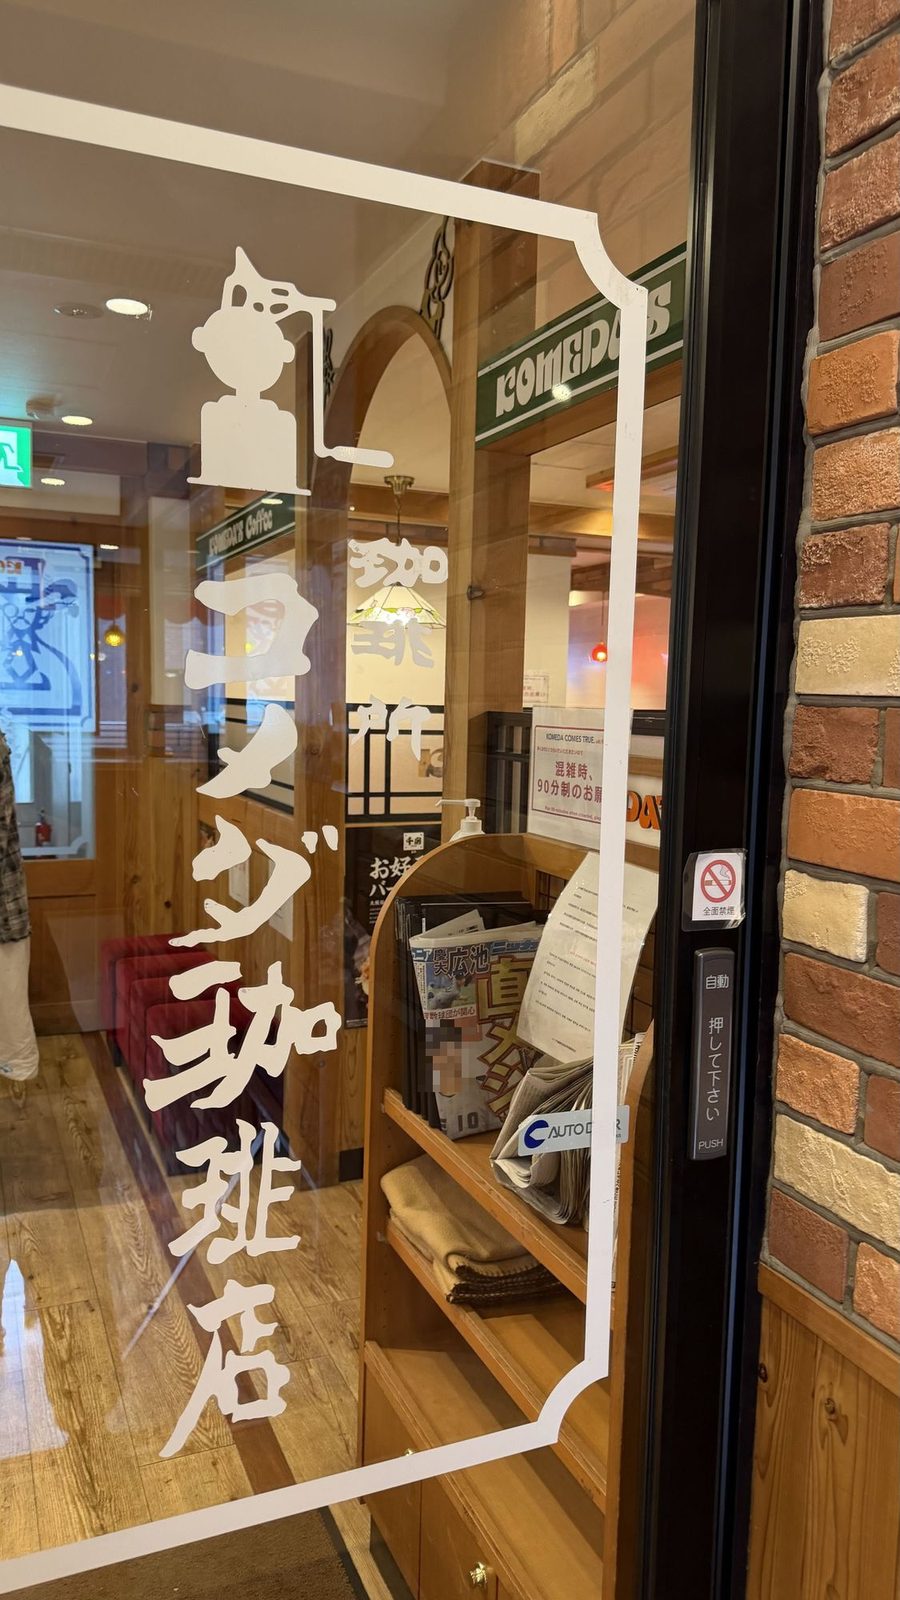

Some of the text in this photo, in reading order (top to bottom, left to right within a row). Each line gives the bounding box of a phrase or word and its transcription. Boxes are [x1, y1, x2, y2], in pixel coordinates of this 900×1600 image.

[564, 734, 582, 743] COMES
[555, 761, 593, 781] 混雑時、
[703, 906, 735, 916] 全面禁煙
[705, 974, 730, 990] 自動
[143, 572, 342, 1459] コメダ珈琲店
[706, 1016, 724, 1121] 押して下さい
[547, 1123, 584, 1139] AUTO
[698, 1138, 724, 1150] PUSH
